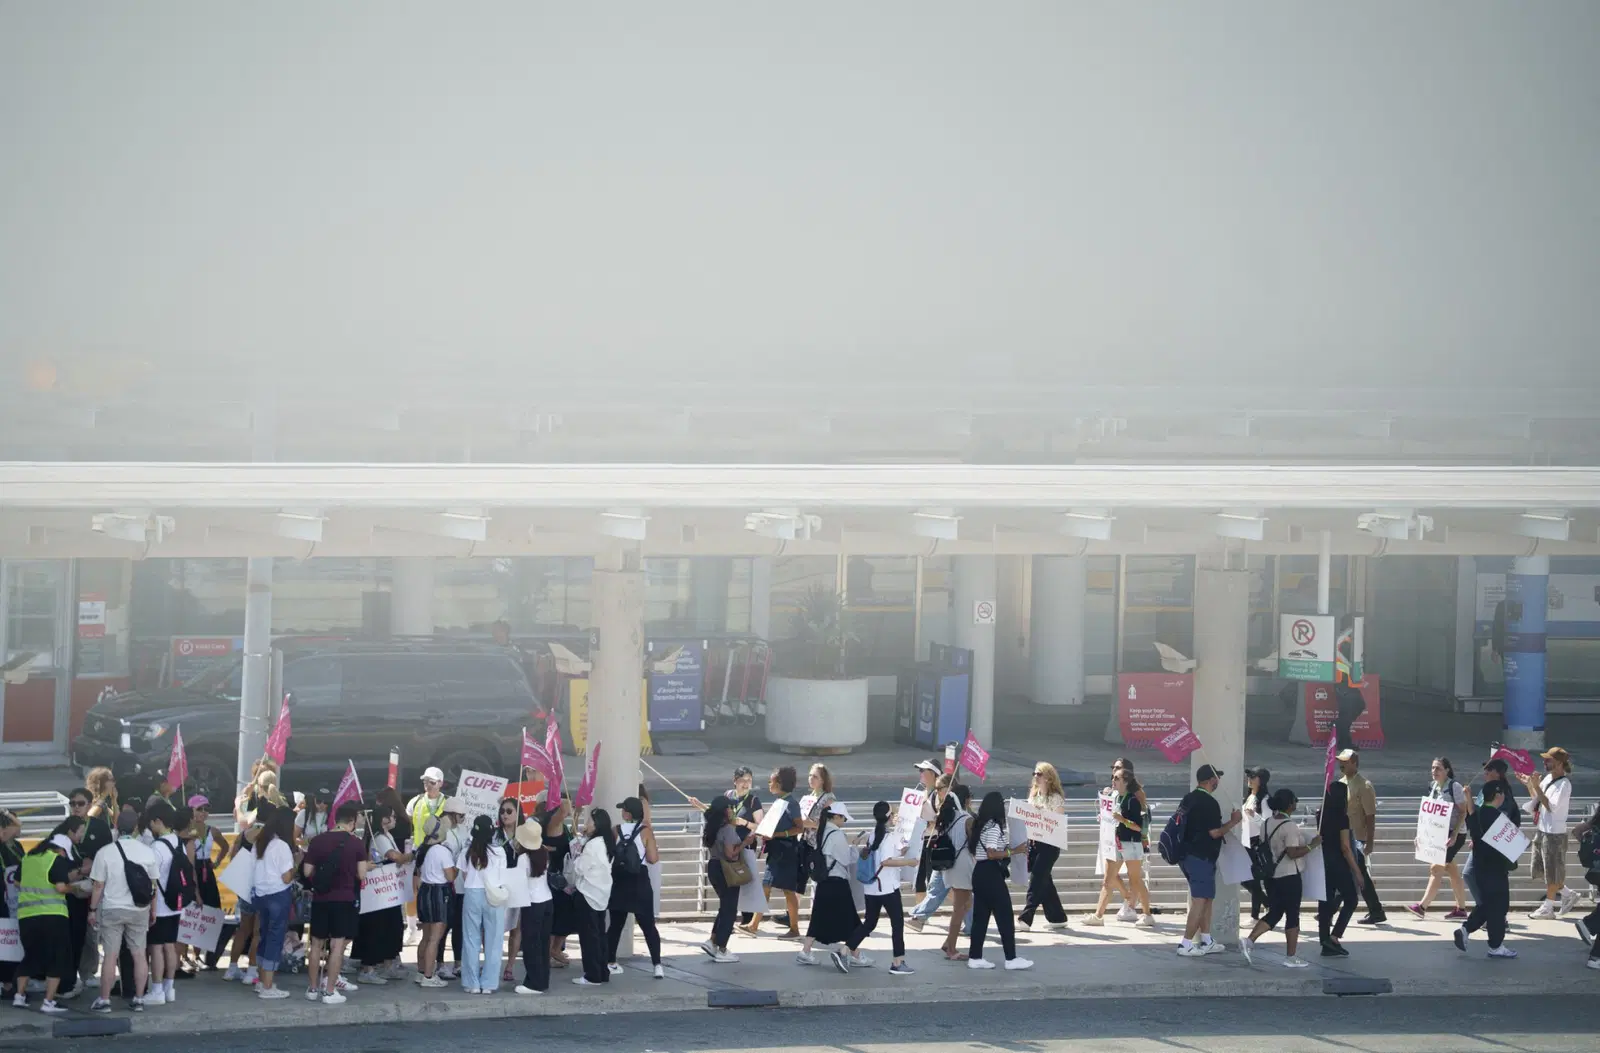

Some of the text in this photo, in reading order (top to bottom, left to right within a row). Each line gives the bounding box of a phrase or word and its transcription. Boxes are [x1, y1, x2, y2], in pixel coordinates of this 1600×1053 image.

[464, 776, 502, 792] CUPE
[520, 794, 537, 803] Cana
[904, 793, 921, 807] CU
[1421, 801, 1449, 816] CUPE
[1015, 806, 1059, 827] Unpaid work
[1024, 820, 1044, 829] won't
[373, 881, 397, 894] won't
[201, 914, 217, 925] work
